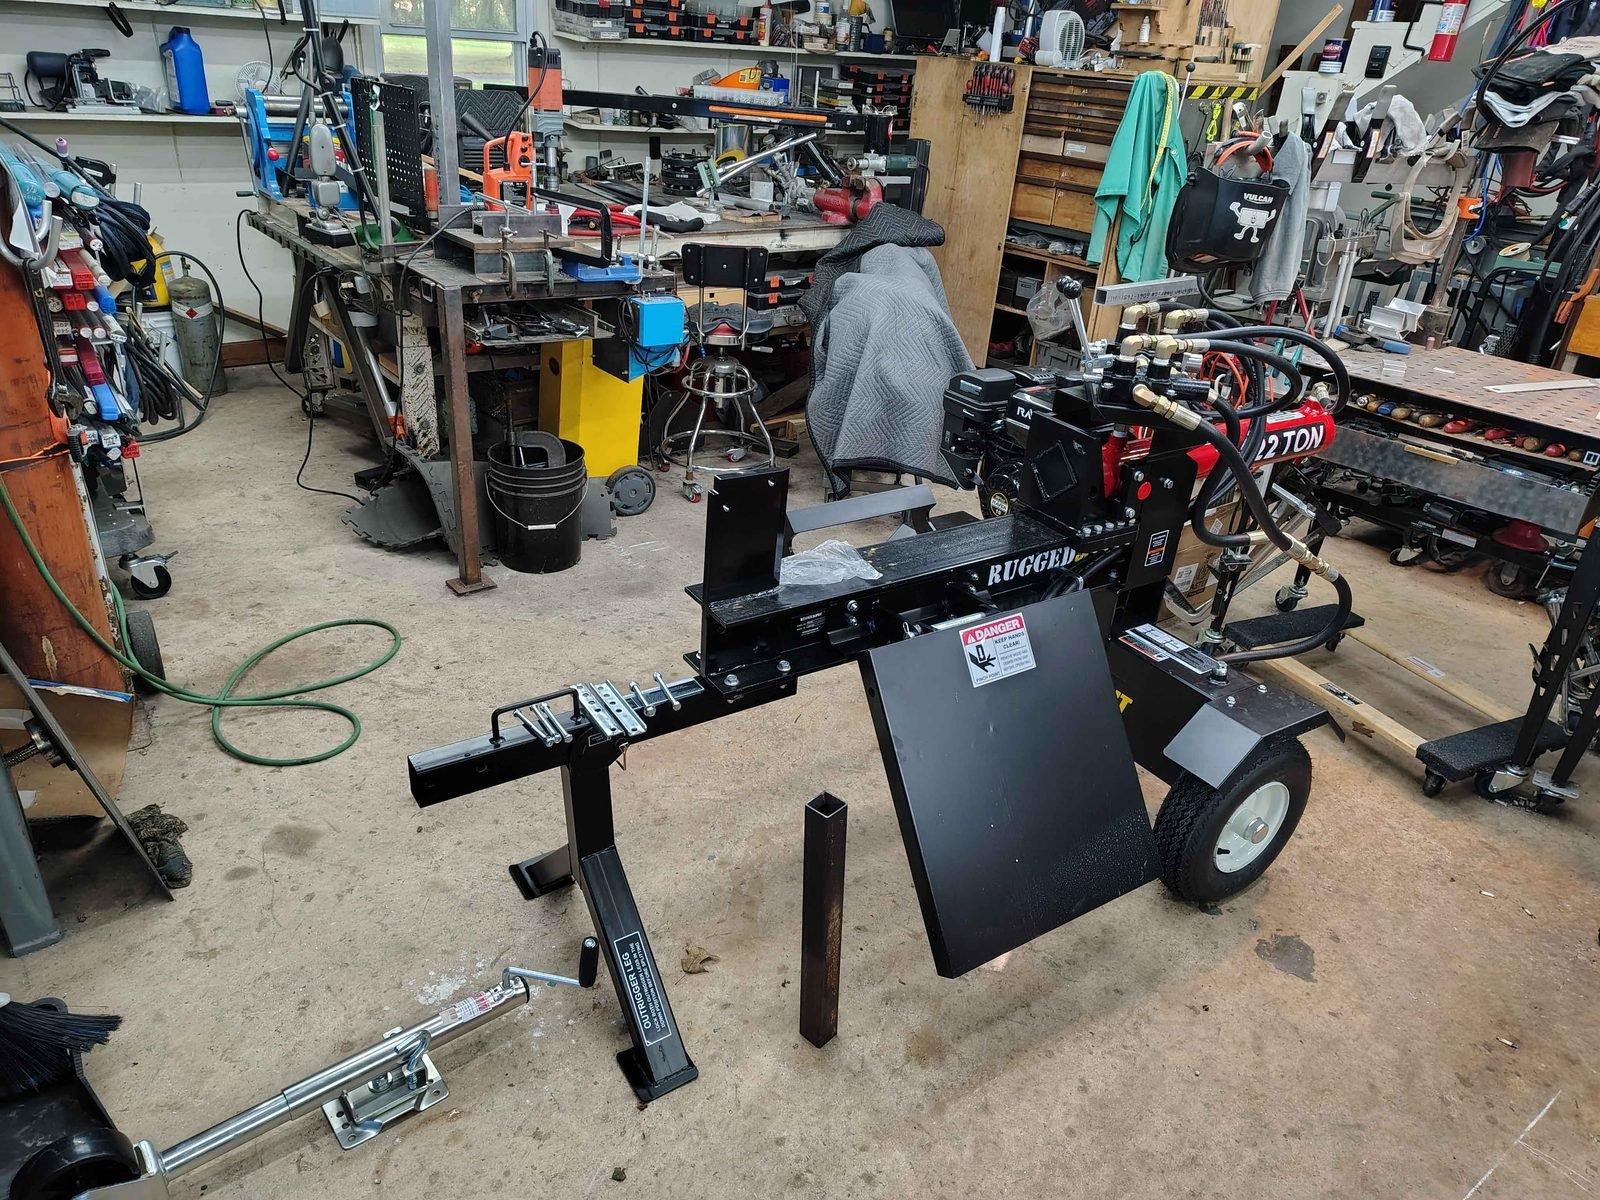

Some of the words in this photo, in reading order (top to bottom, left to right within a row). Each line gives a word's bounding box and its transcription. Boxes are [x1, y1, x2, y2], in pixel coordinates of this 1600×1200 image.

[1244, 193, 1273, 203] VULCAN
[1281, 425, 1324, 455] TON
[987, 546, 1076, 586] RUGGED
[975, 619, 1020, 639] DANGER
[995, 636, 1007, 644] KEEP
[1008, 632, 1024, 640] HANDS
[1003, 640, 1020, 649] CLEAR!
[622, 952, 634, 972] LEG
[635, 942, 646, 967] SPLITTING
[643, 967, 652, 987] BEFORE
[639, 973, 651, 1002] OUTRIGGER
[628, 973, 651, 1029] OUTRIGGER
[650, 987, 659, 1011] POSITION
[653, 1016, 661, 1032] LOCK
[657, 1011, 665, 1027] DOWN
